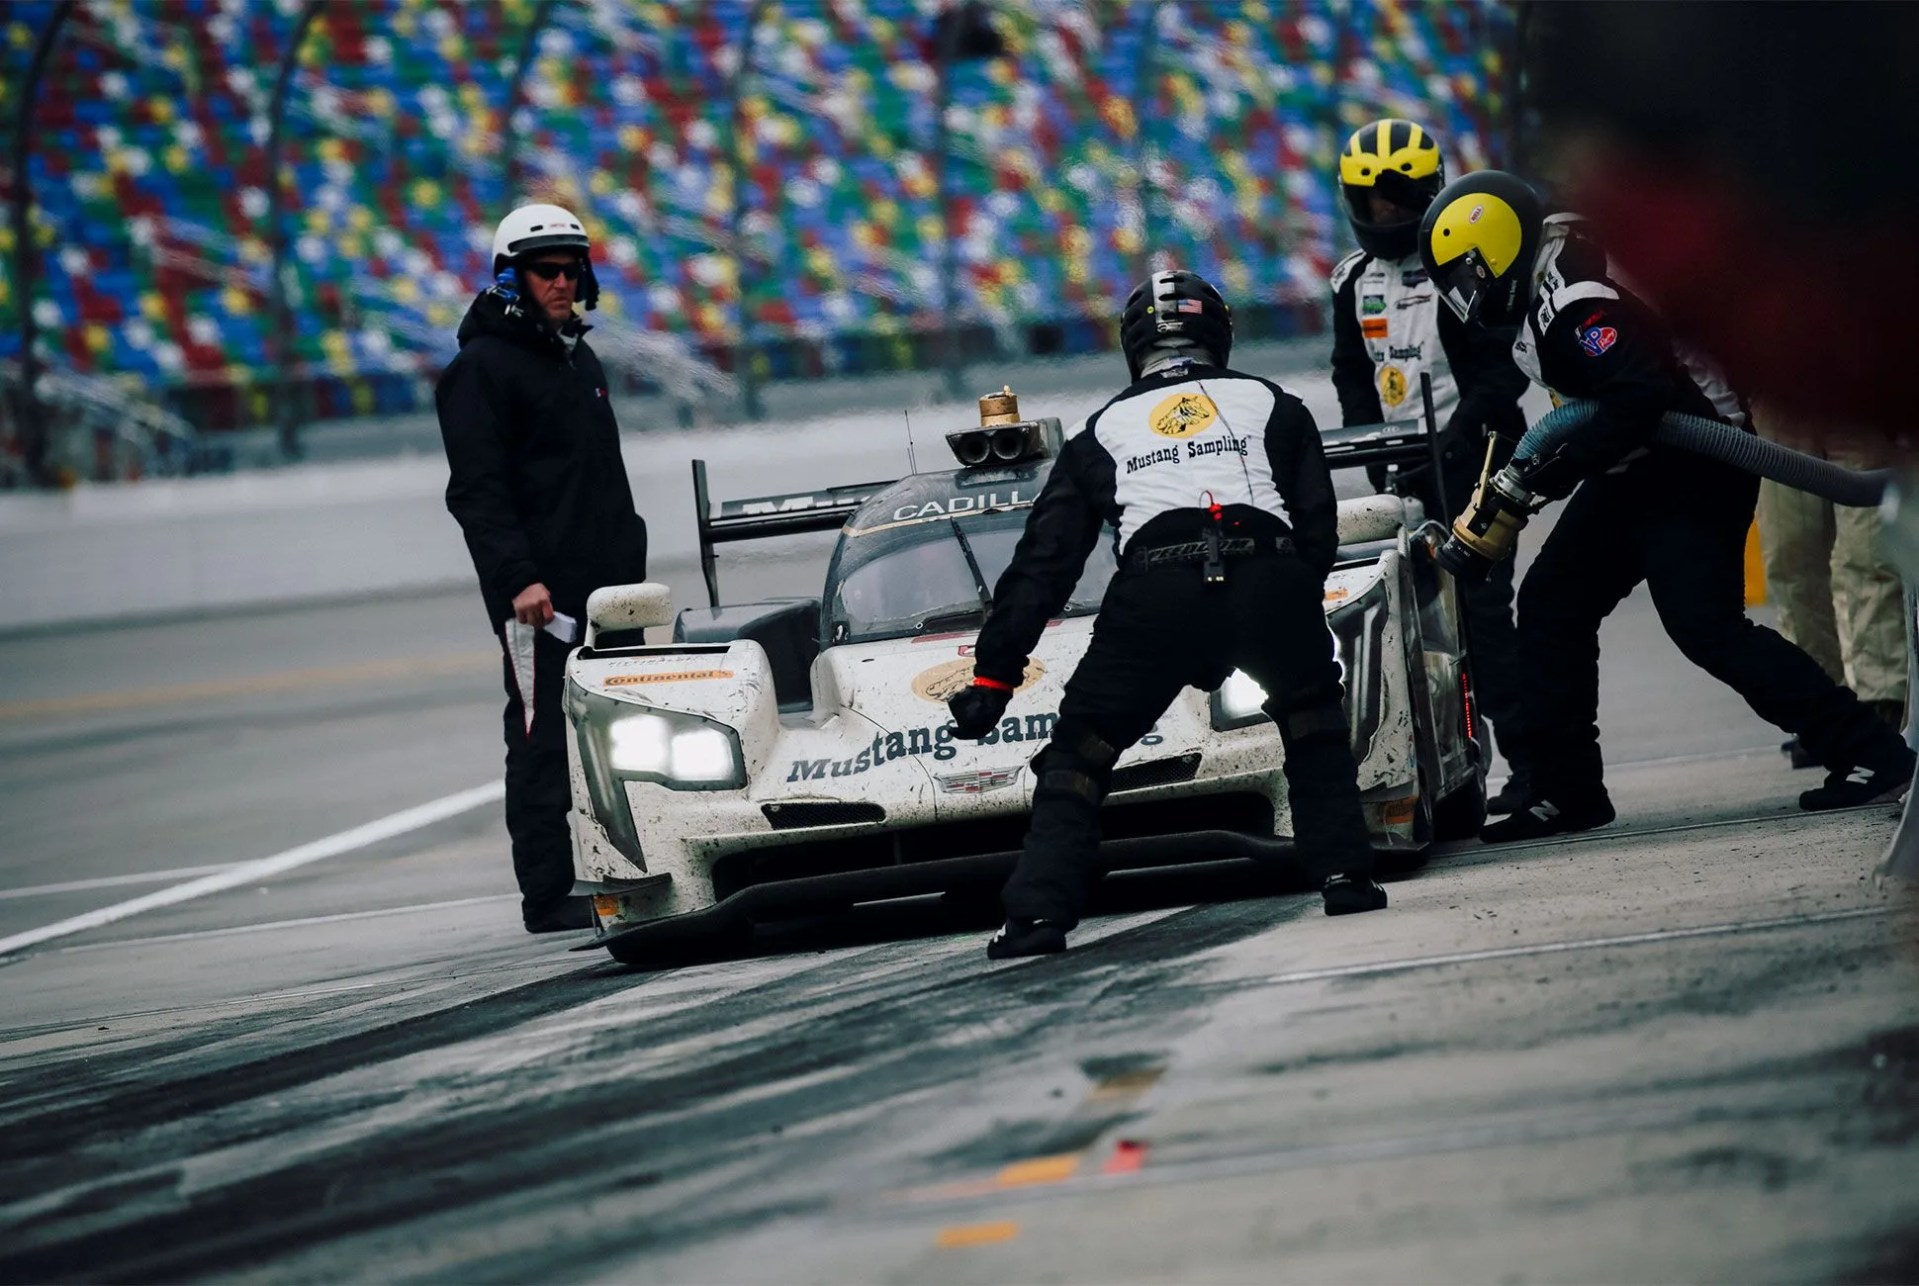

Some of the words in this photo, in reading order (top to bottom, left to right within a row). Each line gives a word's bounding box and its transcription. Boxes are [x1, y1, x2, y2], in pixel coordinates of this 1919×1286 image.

[1127, 445, 1180, 474] Mustang
[1187, 436, 1248, 458] Sampling
[893, 491, 1042, 521] CADILL
[787, 719, 957, 782] Mustang
